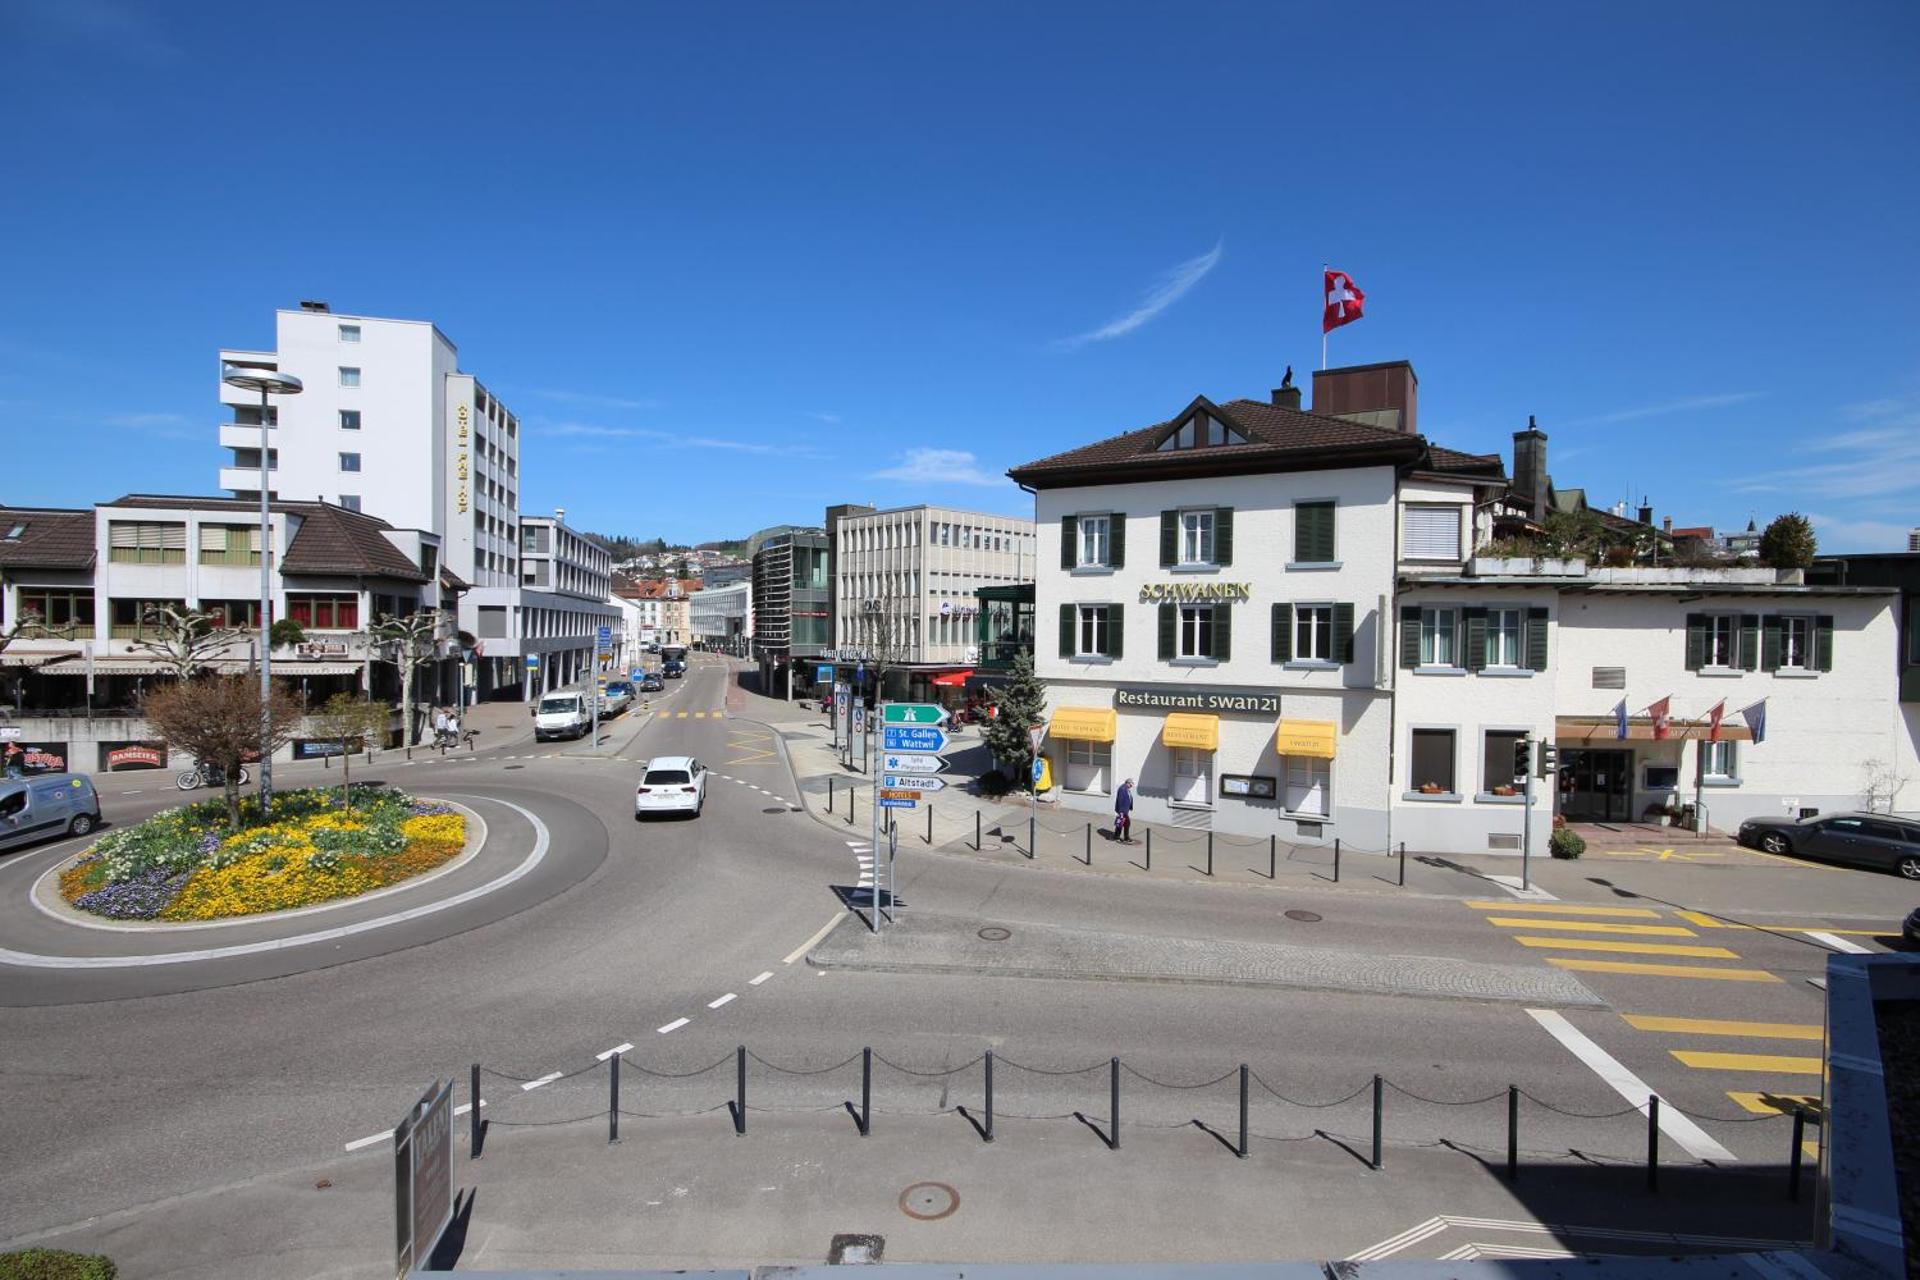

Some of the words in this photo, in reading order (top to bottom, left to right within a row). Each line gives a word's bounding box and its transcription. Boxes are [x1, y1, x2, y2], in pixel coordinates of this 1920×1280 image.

[1141, 582, 1251, 600] SCHWANEN
[1118, 690, 1204, 708] Restaurant
[898, 729, 910, 738] St.
[911, 729, 938, 739] Gallen
[901, 738, 934, 749] Wattwil
[899, 777, 934, 788] Altstadt
